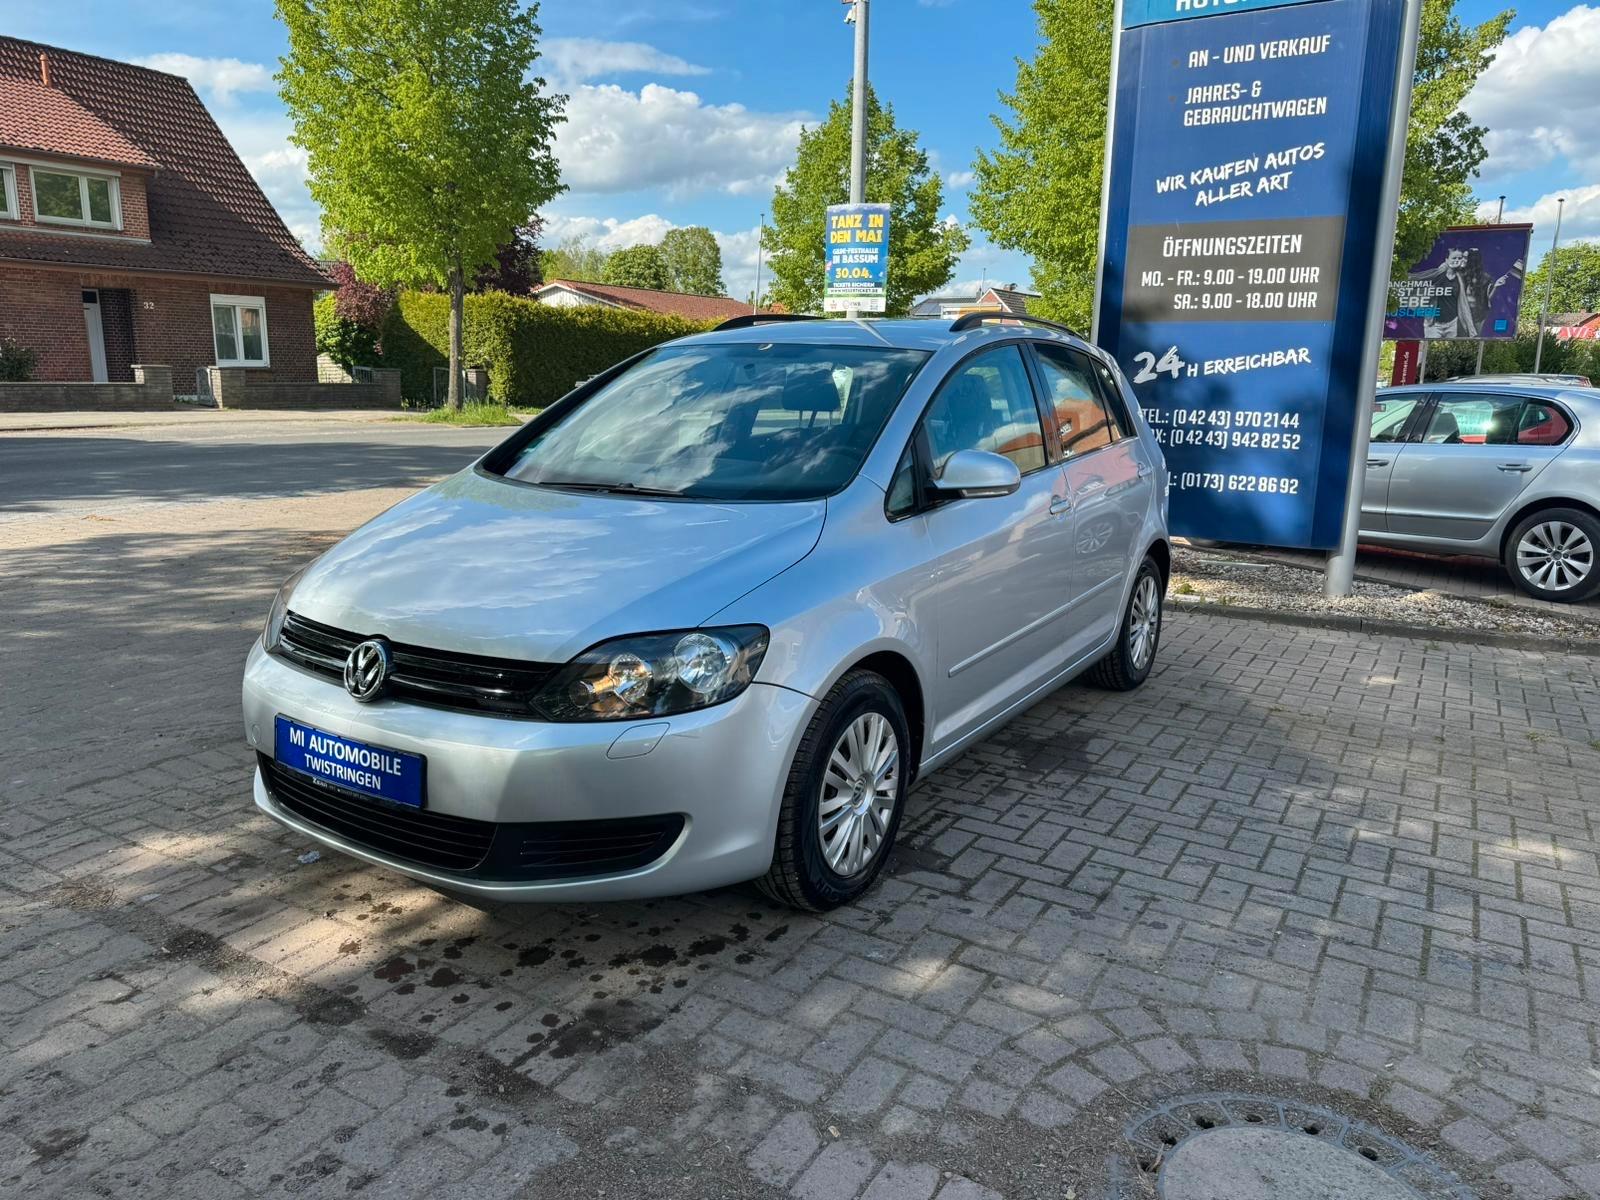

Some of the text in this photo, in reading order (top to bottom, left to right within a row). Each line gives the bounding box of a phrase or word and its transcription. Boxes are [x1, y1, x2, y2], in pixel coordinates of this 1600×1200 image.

[1188, 50, 1209, 68] AN
[1223, 44, 1255, 63] UND
[1260, 34, 1331, 59] VERKAUF
[1185, 80, 1262, 105] JAHRES- &
[1183, 96, 1327, 126] GEBRAUCHTWAGEN
[1156, 142, 1325, 194] WIR KAUFEN AUTOS
[1195, 171, 1293, 206] ALLER ART
[831, 214, 884, 229] TANZ IN
[830, 229, 883, 244] DEN MAI
[1163, 233, 1303, 257] ÖFFNUNGSZEITEN
[832, 254, 879, 265] IN BASSUM
[835, 267, 873, 279] 30.04.
[1141, 270, 1165, 287] MO.
[1176, 269, 1200, 286] FR.:
[1203, 268, 1234, 286] 9.00
[1247, 267, 1286, 285] 19.00
[1289, 266, 1320, 284] UHR
[1388, 280, 1434, 288] ANCHMAL
[1173, 294, 1198, 310] SA.:
[1201, 293, 1233, 309] 9.00
[1245, 292, 1284, 309] 18.00
[1287, 291, 1318, 308] UHR
[1417, 286, 1453, 297] LIEBE
[143, 301, 155, 310] 32
[1133, 345, 1312, 385] 24 H ERREICHBAR
[289, 727, 402, 776] MI AUTOMOBILE
[304, 753, 381, 790] TWISTRINGEN
